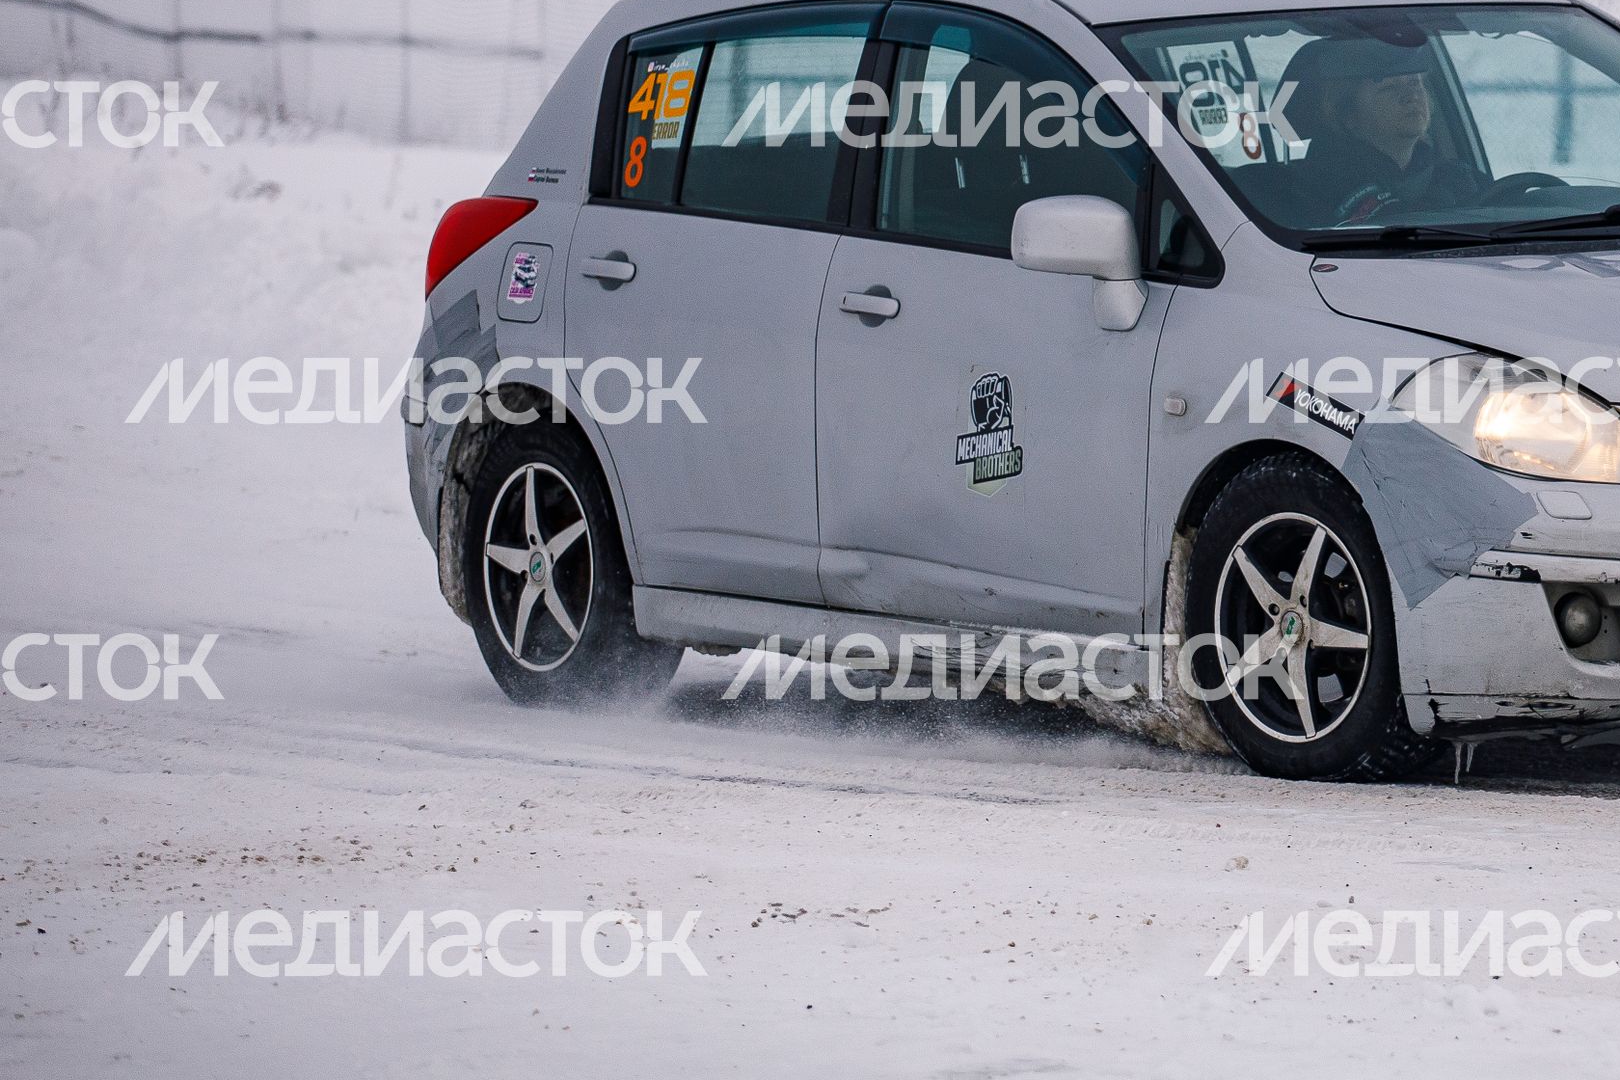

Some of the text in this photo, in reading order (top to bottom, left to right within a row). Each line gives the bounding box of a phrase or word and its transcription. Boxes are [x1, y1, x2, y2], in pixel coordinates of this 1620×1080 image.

[628, 69, 695, 120] 418
[652, 121, 680, 140] ERROR
[624, 135, 647, 188] 8
[1294, 389, 1357, 435] YOKOHAMA
[957, 429, 1012, 461] MECHANICAL
[976, 449, 1021, 480] BROTHERS
